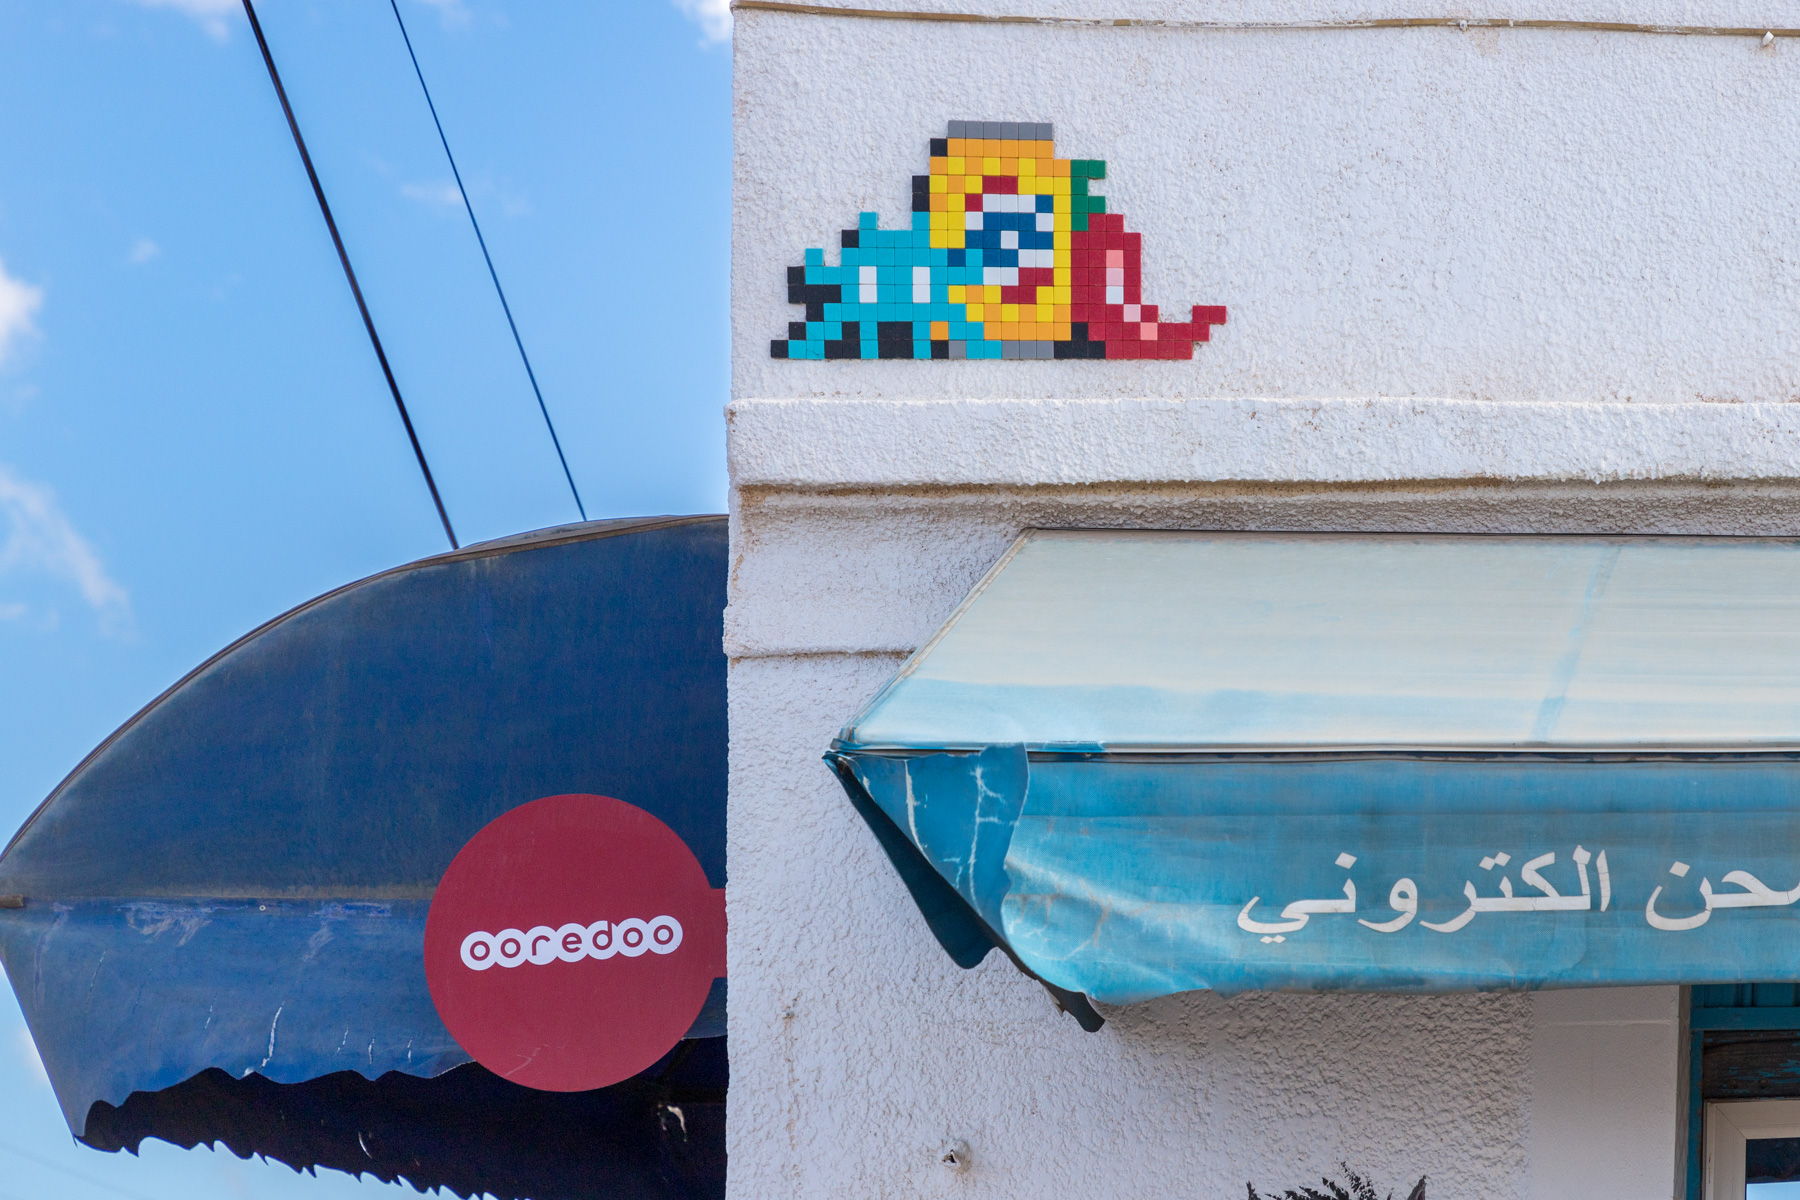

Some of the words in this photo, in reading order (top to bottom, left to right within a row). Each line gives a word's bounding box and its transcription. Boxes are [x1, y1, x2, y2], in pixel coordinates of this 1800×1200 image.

[1236, 845, 1611, 944] الكتروني
[1645, 861, 1800, 931] حن
[461, 916, 682, 970] ooredoo
